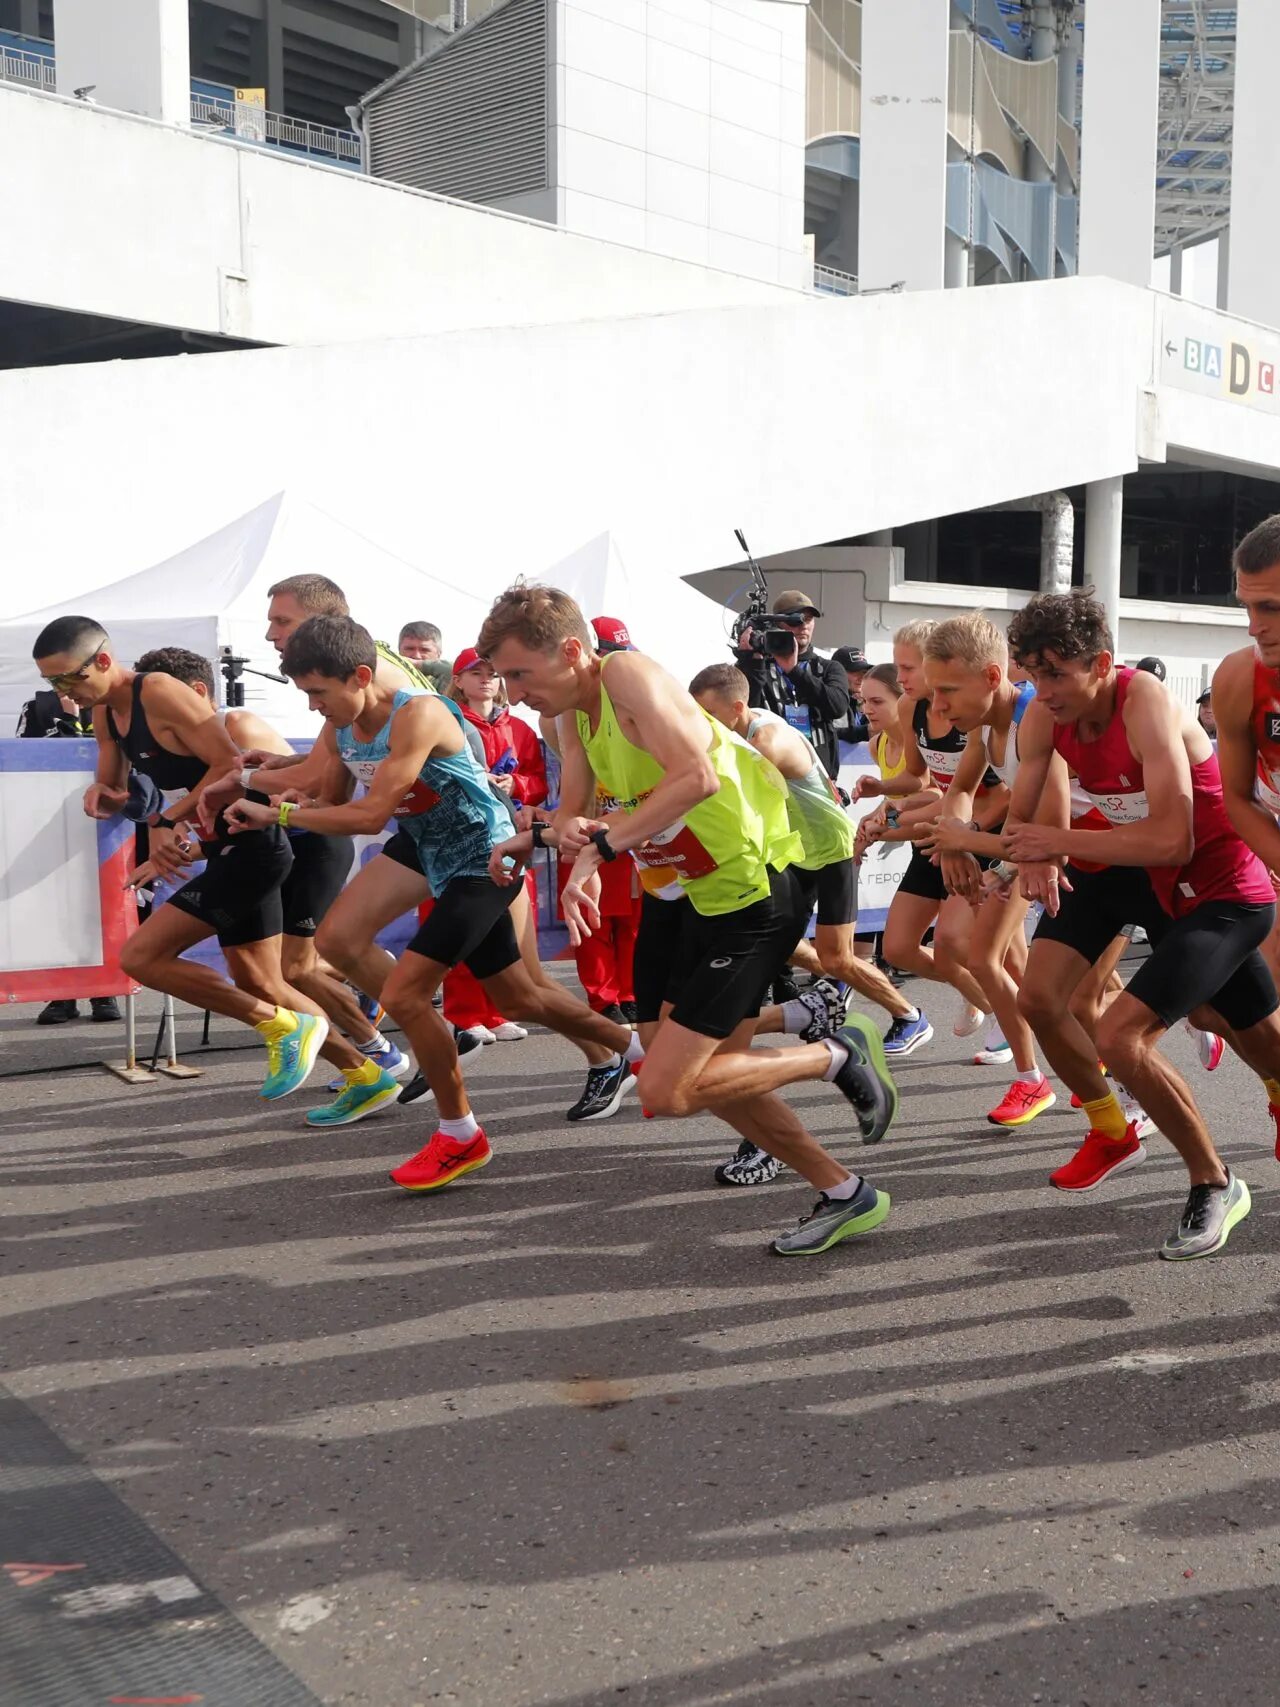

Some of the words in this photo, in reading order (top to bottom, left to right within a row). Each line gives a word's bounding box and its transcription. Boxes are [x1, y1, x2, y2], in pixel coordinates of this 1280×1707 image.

[1186, 339, 1199, 370] B
[1205, 346, 1220, 377] A
[1230, 342, 1250, 396] D
[1260, 364, 1272, 392] C
